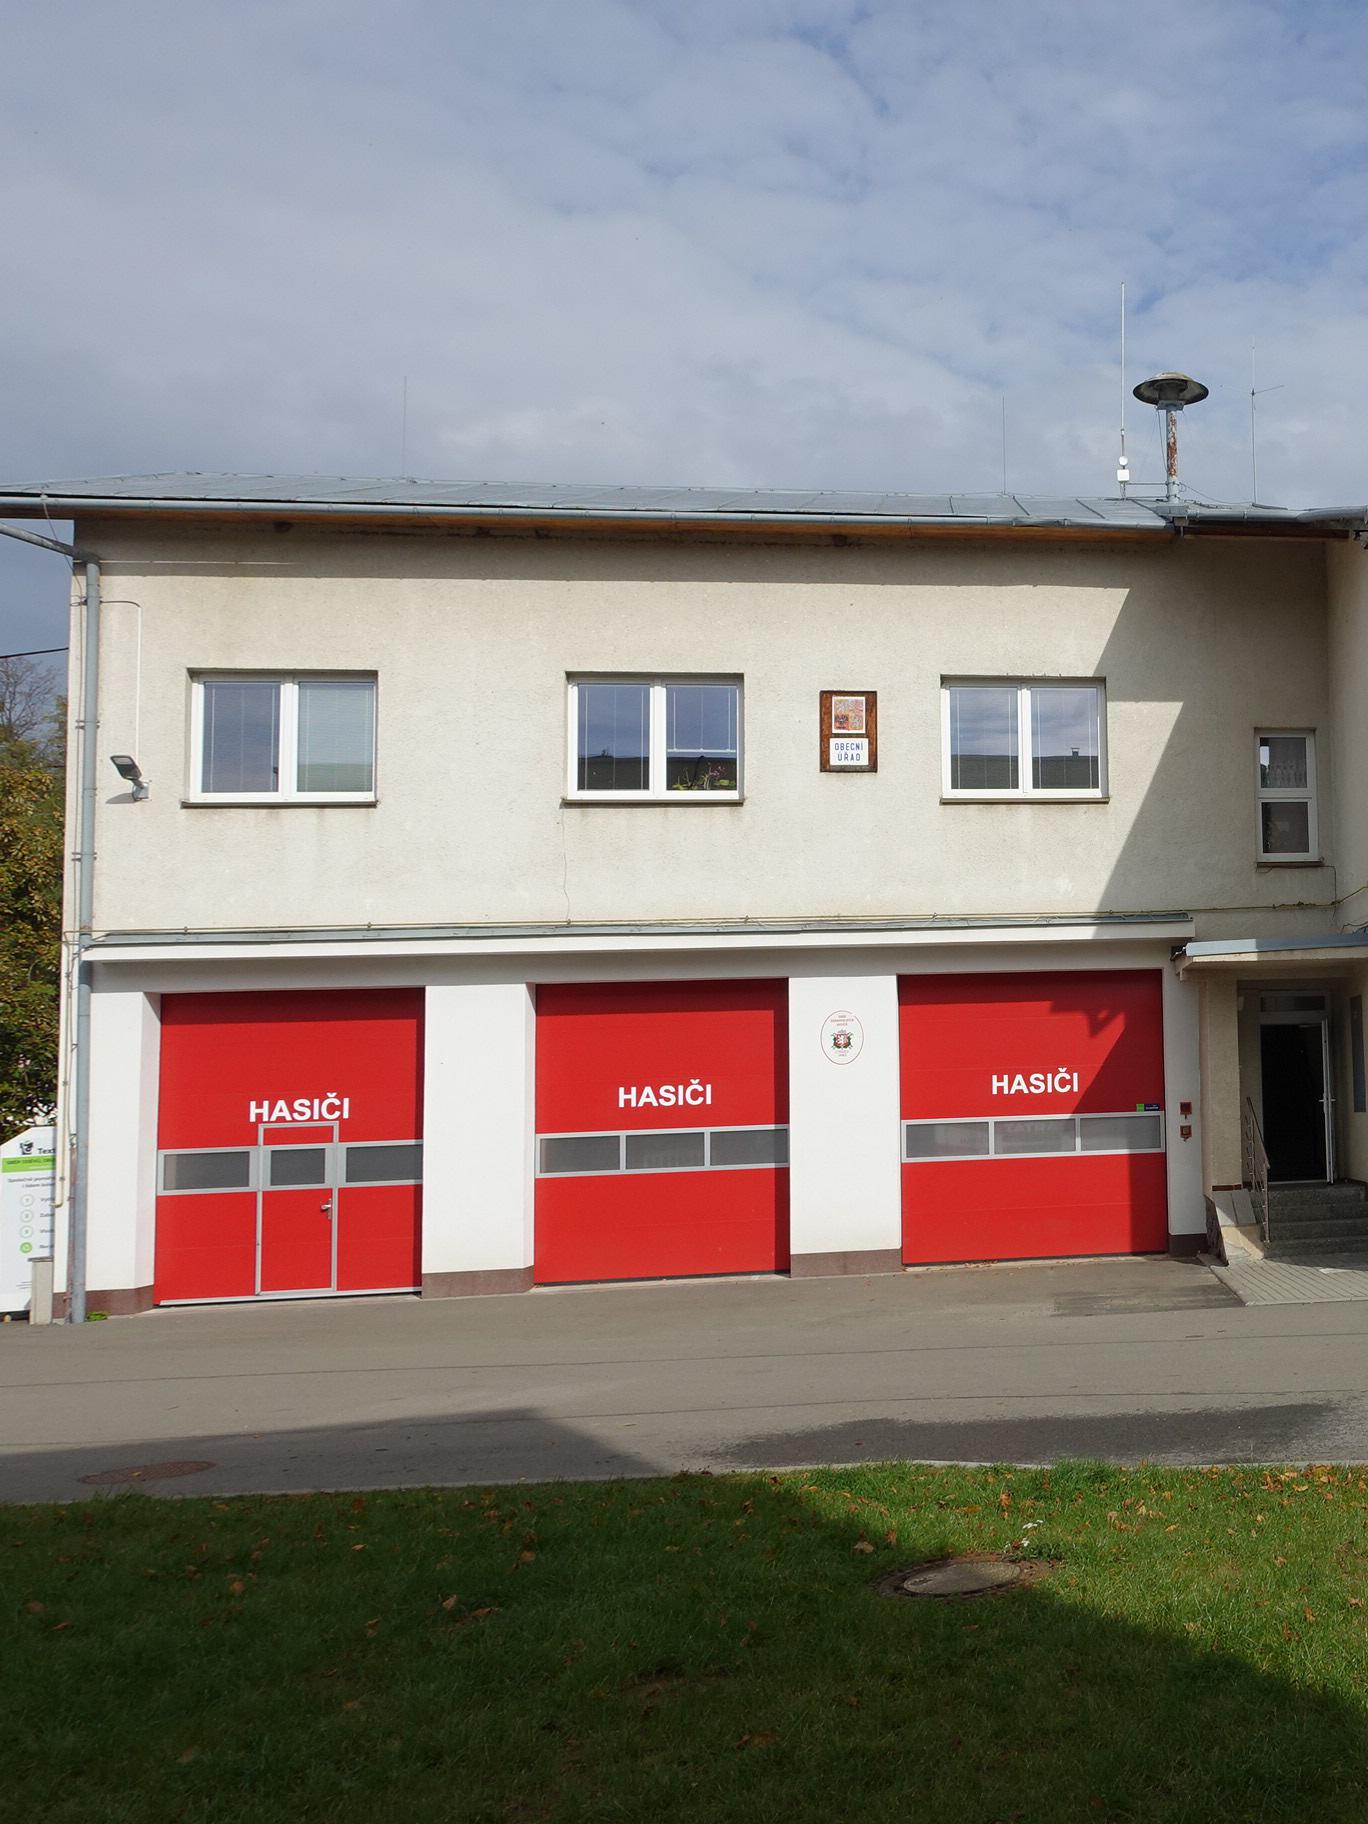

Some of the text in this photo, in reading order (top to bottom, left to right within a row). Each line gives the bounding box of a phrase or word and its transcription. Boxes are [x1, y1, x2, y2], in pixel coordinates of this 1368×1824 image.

[834, 741, 864, 751] OBECNÍ
[837, 751, 861, 762] ÚŘAD
[618, 1078, 712, 1108] HASIČI
[991, 1067, 1079, 1095] HASIČI
[249, 1092, 350, 1122] HASIČI
